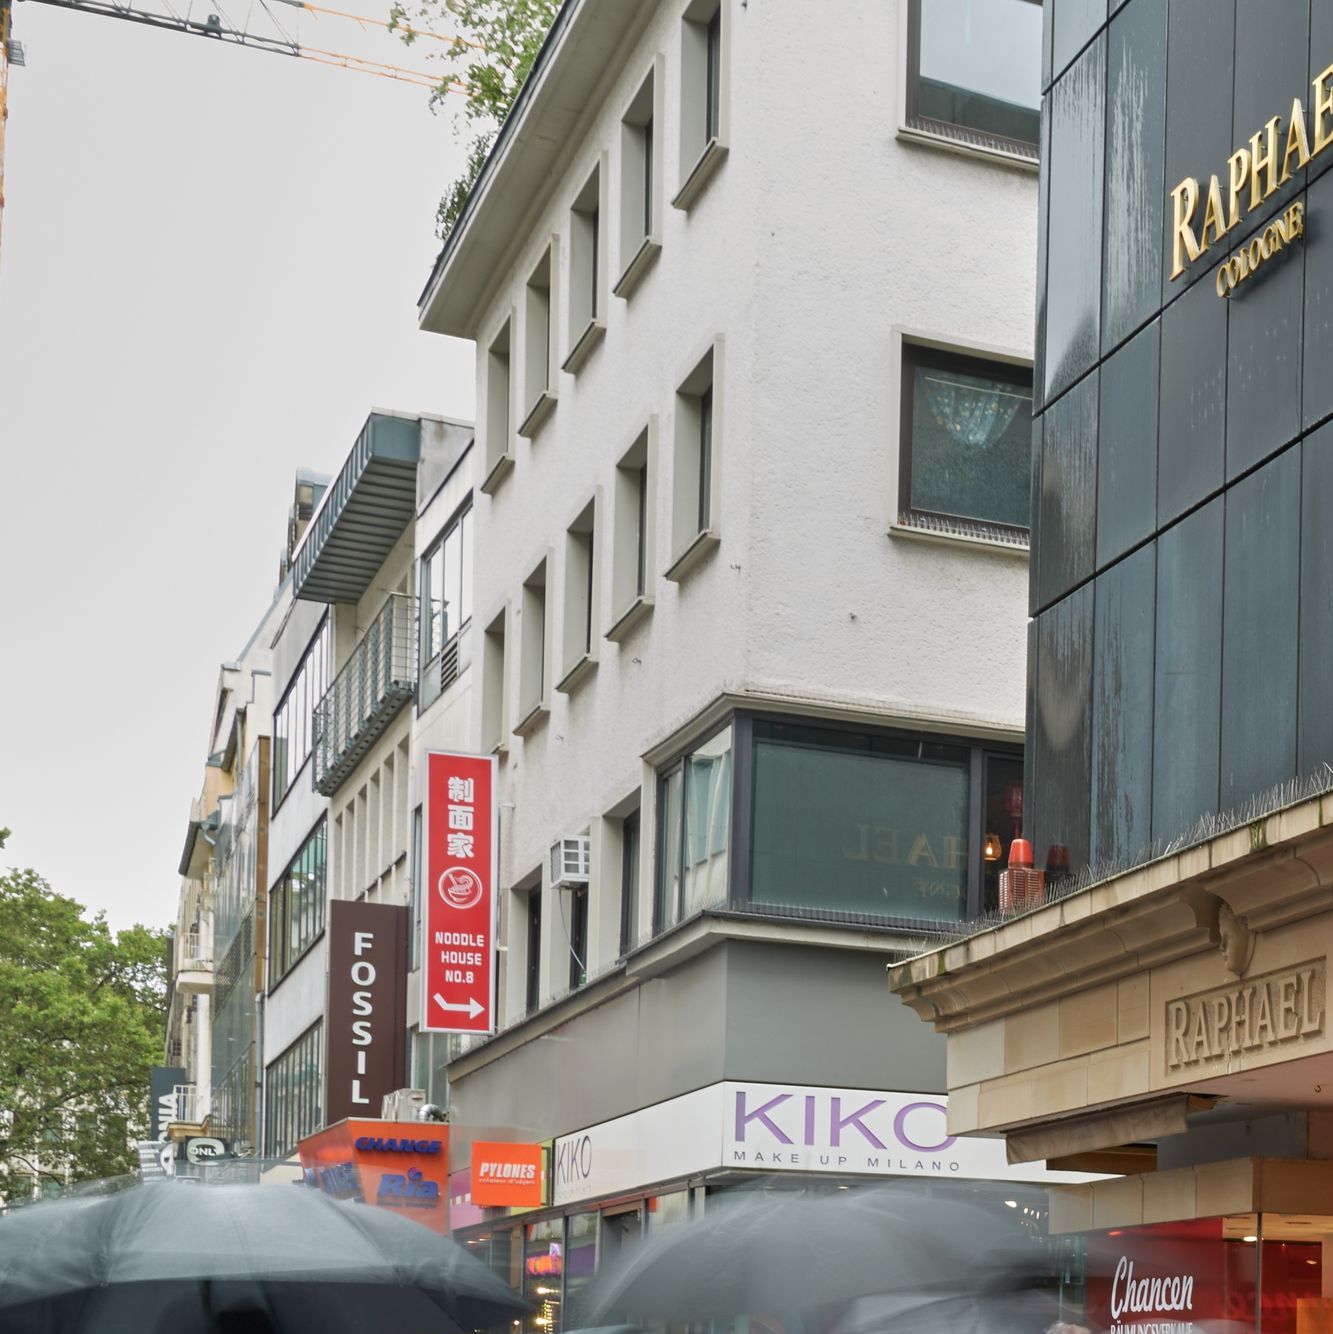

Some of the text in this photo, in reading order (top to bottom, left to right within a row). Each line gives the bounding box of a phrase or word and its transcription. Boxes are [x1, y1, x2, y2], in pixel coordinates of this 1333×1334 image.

[1216, 201, 1305, 298] COLOGNE
[447, 776, 475, 860] 制面家
[435, 931, 484, 948] NOODLE
[441, 951, 482, 966] HOUSE
[445, 970, 474, 984] NO.8
[351, 930, 377, 1105] FOSSIL
[1168, 969, 1323, 1067] RAPHAEL
[735, 1091, 958, 1153] KIKO
[355, 1136, 442, 1154] CHANGE
[557, 1135, 592, 1186] KIKO
[734, 1150, 960, 1172] MAKE UP MILANO
[378, 1167, 439, 1199] Ria
[479, 1162, 536, 1179] PYLONES
[1111, 1255, 1194, 1319] Chancen
